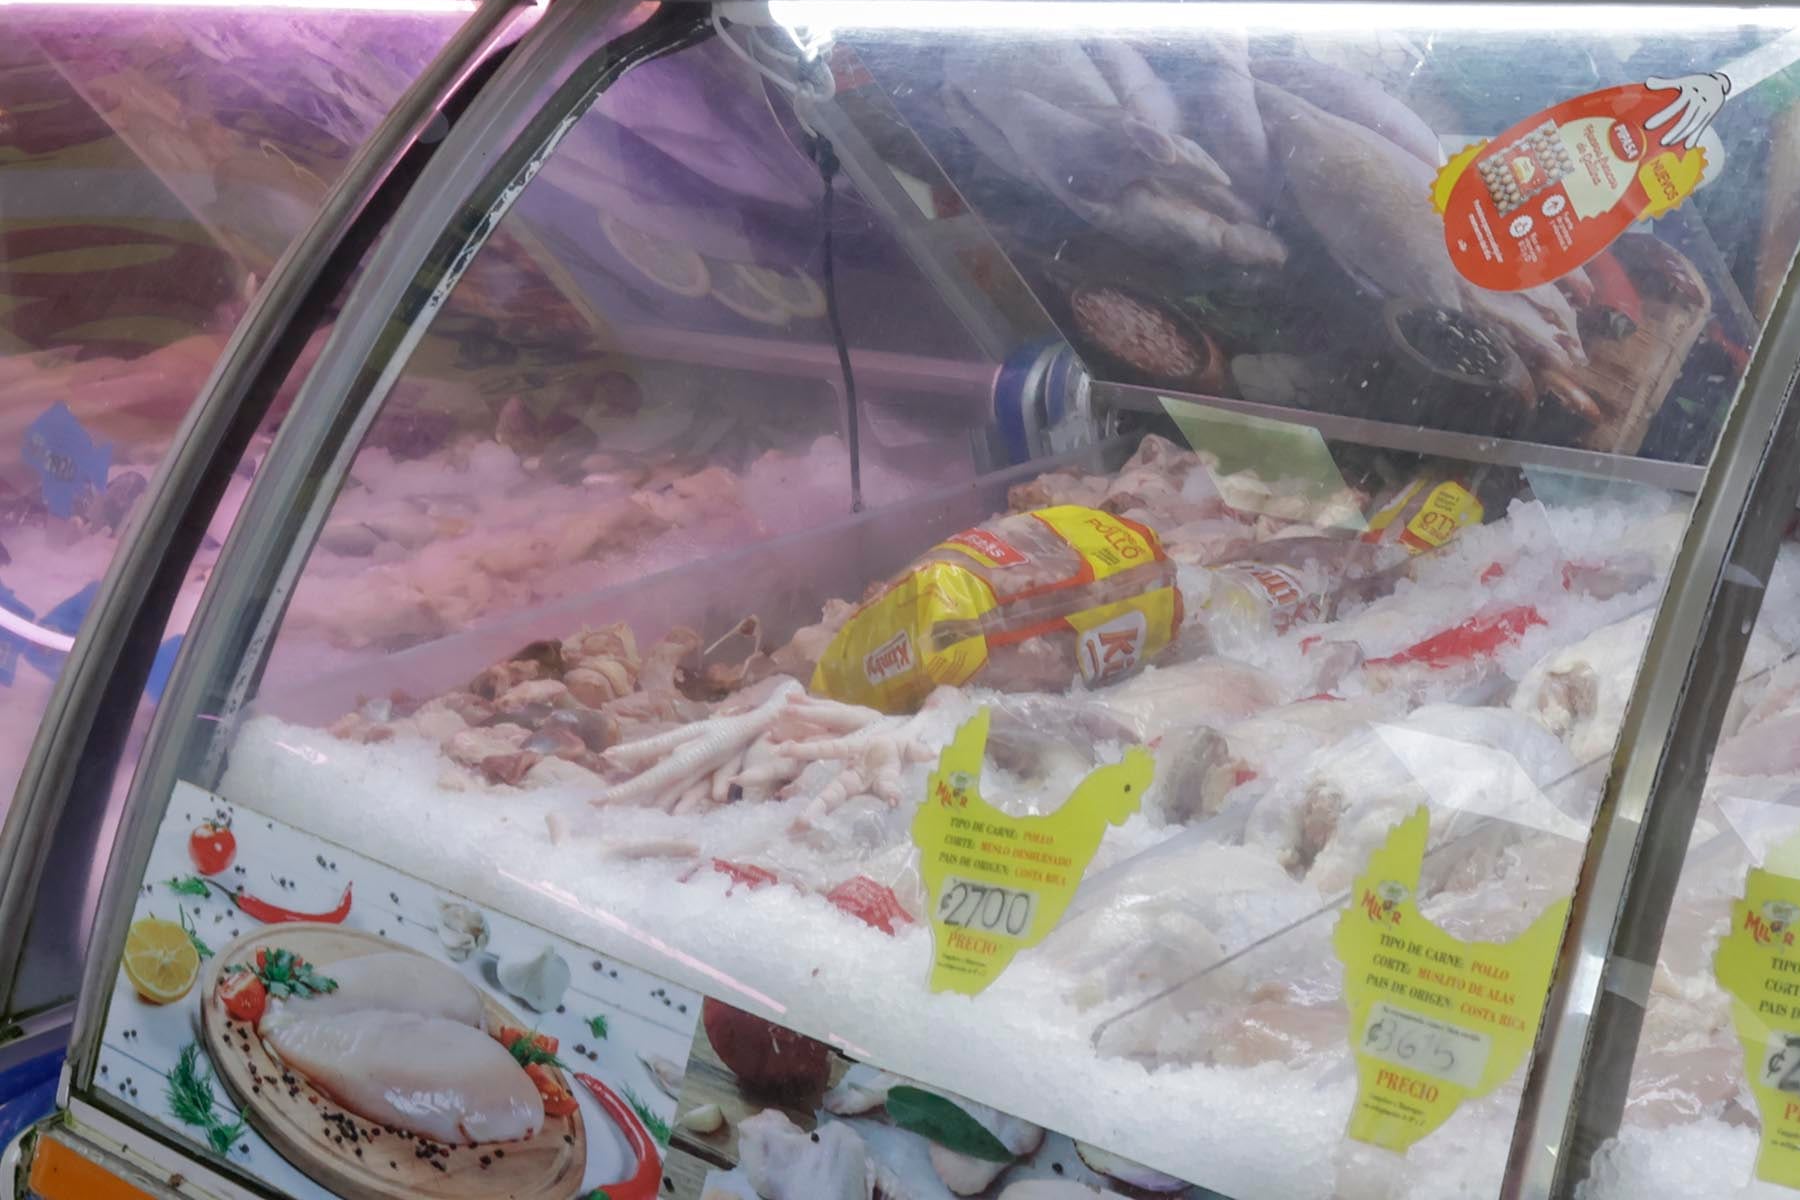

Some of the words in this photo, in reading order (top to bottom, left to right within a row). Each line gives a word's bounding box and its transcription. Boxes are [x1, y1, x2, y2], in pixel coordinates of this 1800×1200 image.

[1651, 158, 1679, 202] NUEVOS
[1088, 518, 1140, 559] POLLO
[972, 821, 986, 834] DE
[947, 931, 997, 956] PRECIO
[1380, 933, 1407, 952] TIPO
[1408, 939, 1423, 957] DE
[1471, 960, 1510, 982] POLLO
[1372, 953, 1412, 977] CORTE:
[1468, 979, 1487, 998] DE
[1366, 973, 1390, 991] PAIS
[1391, 978, 1407, 996] DE
[1460, 1002, 1498, 1024] COSTA
[1758, 999, 1789, 1018] PAIS
[1376, 1068, 1439, 1104] PRECIO
